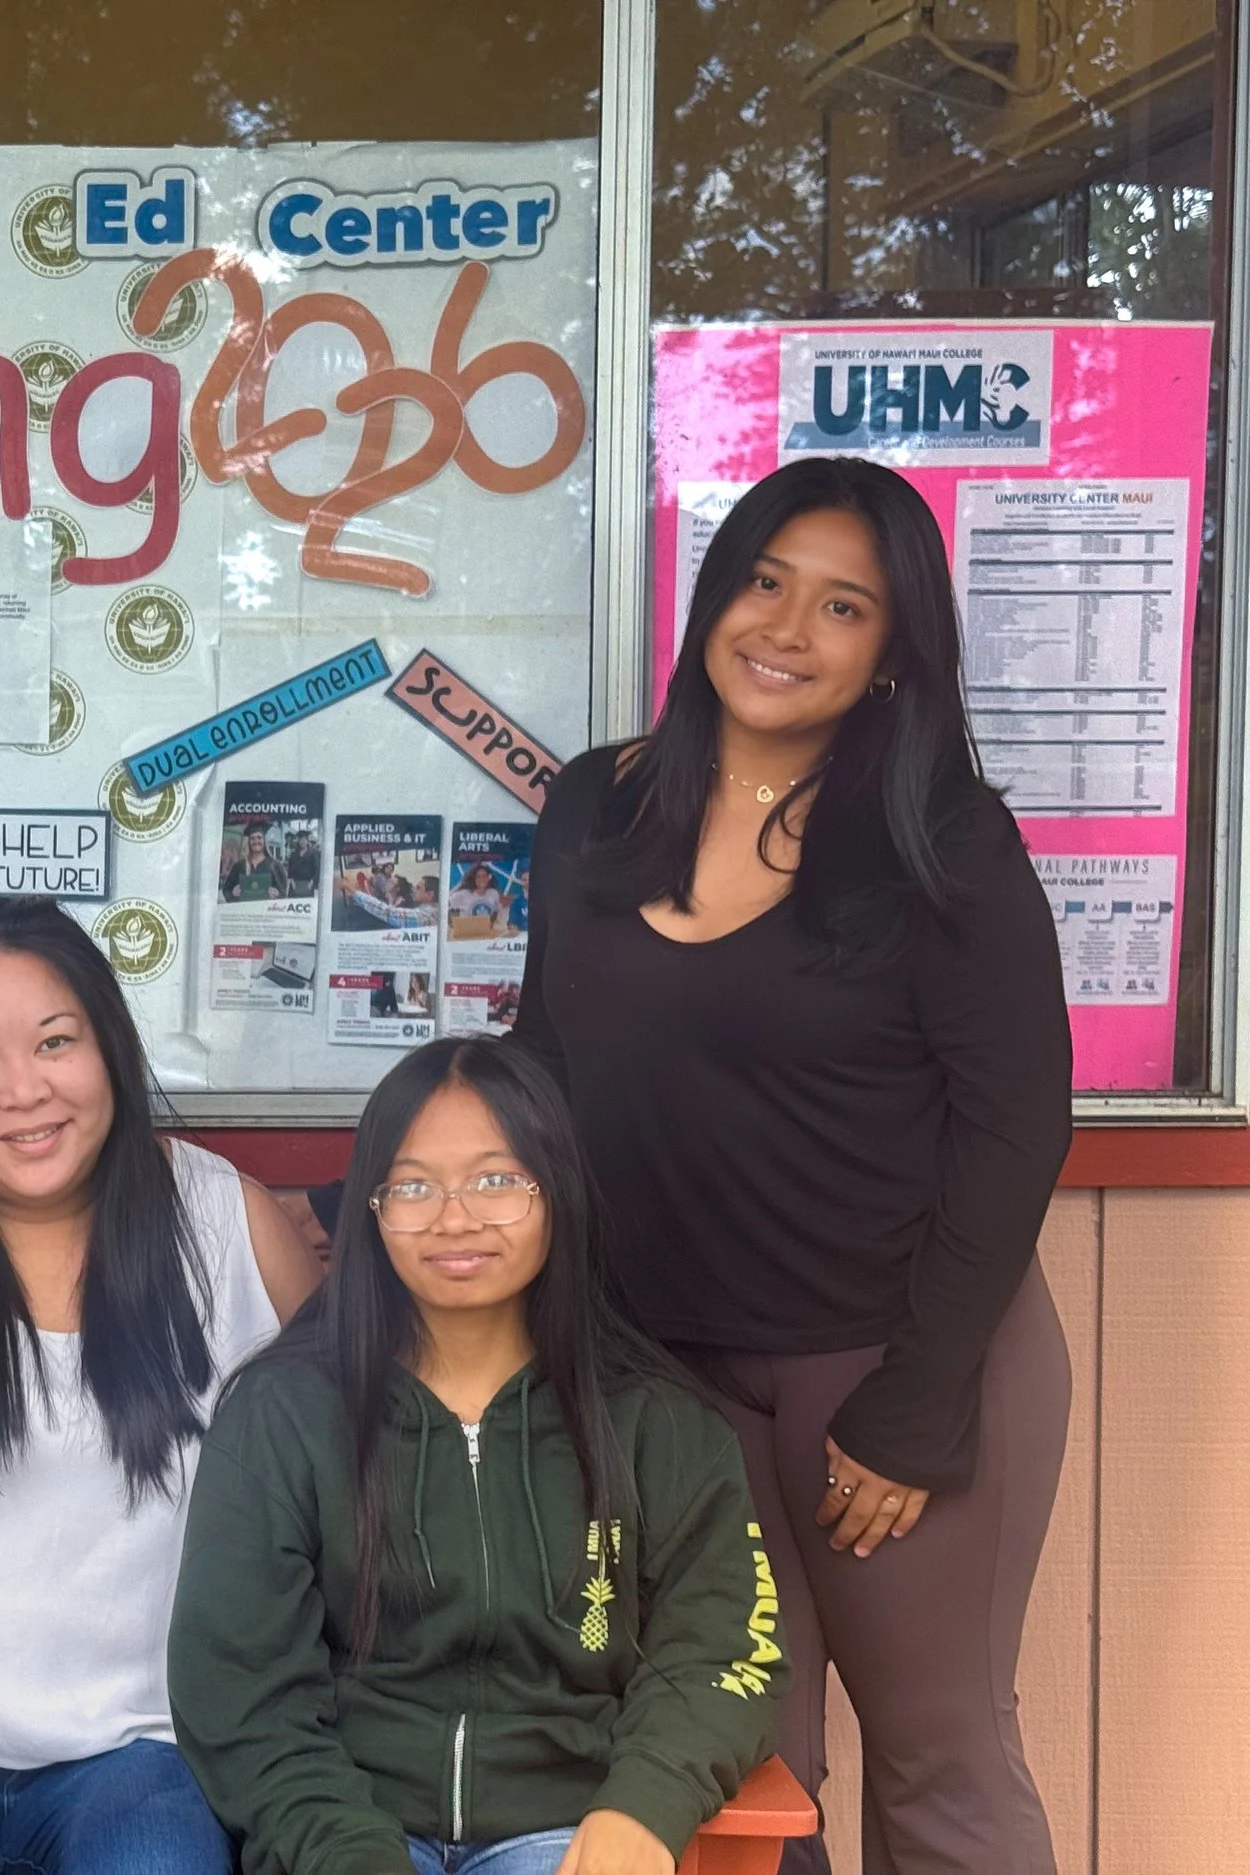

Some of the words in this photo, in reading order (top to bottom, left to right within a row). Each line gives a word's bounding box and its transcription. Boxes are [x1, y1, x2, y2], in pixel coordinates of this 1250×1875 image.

[86, 178, 185, 244] Ed
[268, 192, 551, 255] Center
[814, 349, 866, 360] UNIVERSITY
[868, 349, 880, 359] OF
[918, 349, 941, 359] MAUI
[942, 348, 983, 359] COLLEGE
[812, 362, 1031, 437] UHMC
[133, 248, 586, 597] 2026
[986, 434, 1026, 448] Courses
[994, 493, 1066, 505] UNIVERSITY
[1122, 492, 1153, 503] MAUI
[405, 666, 556, 795] SUPPOR
[229, 803, 307, 815] ACCOUNTING
[344, 823, 395, 833] APPLIED
[2, 823, 98, 860] HELP
[343, 833, 401, 844] BUSINESS
[403, 833, 412, 843] &
[414, 833, 427, 843] IT
[459, 832, 510, 843] LIBERAL
[458, 842, 490, 852] ARTS
[1034, 859, 1062, 874] NAL
[1071, 859, 1150, 874] PATHWAYS
[1060, 877, 1105, 887] COLLEGE
[286, 903, 312, 914] ACC
[401, 931, 431, 942] ABIT
[219, 947, 227, 957] 2
[337, 976, 347, 988] 4
[450, 984, 459, 995] 2
